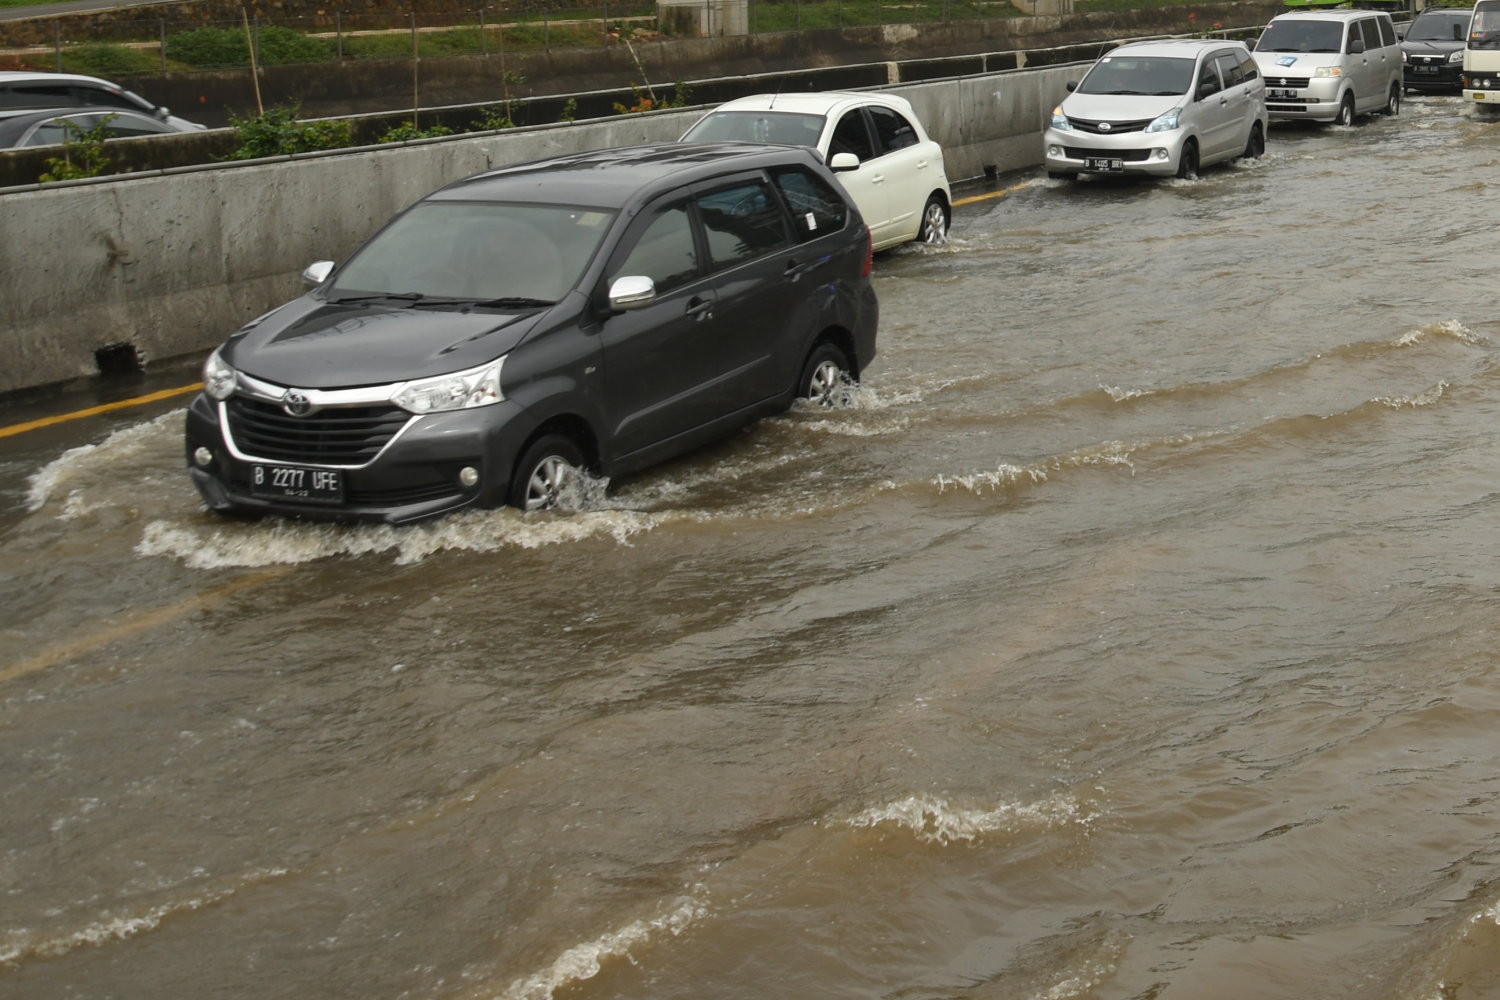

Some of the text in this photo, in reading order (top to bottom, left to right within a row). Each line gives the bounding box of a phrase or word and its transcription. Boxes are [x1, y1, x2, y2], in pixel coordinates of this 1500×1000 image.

[255, 466, 338, 491] B 2277 UFE
